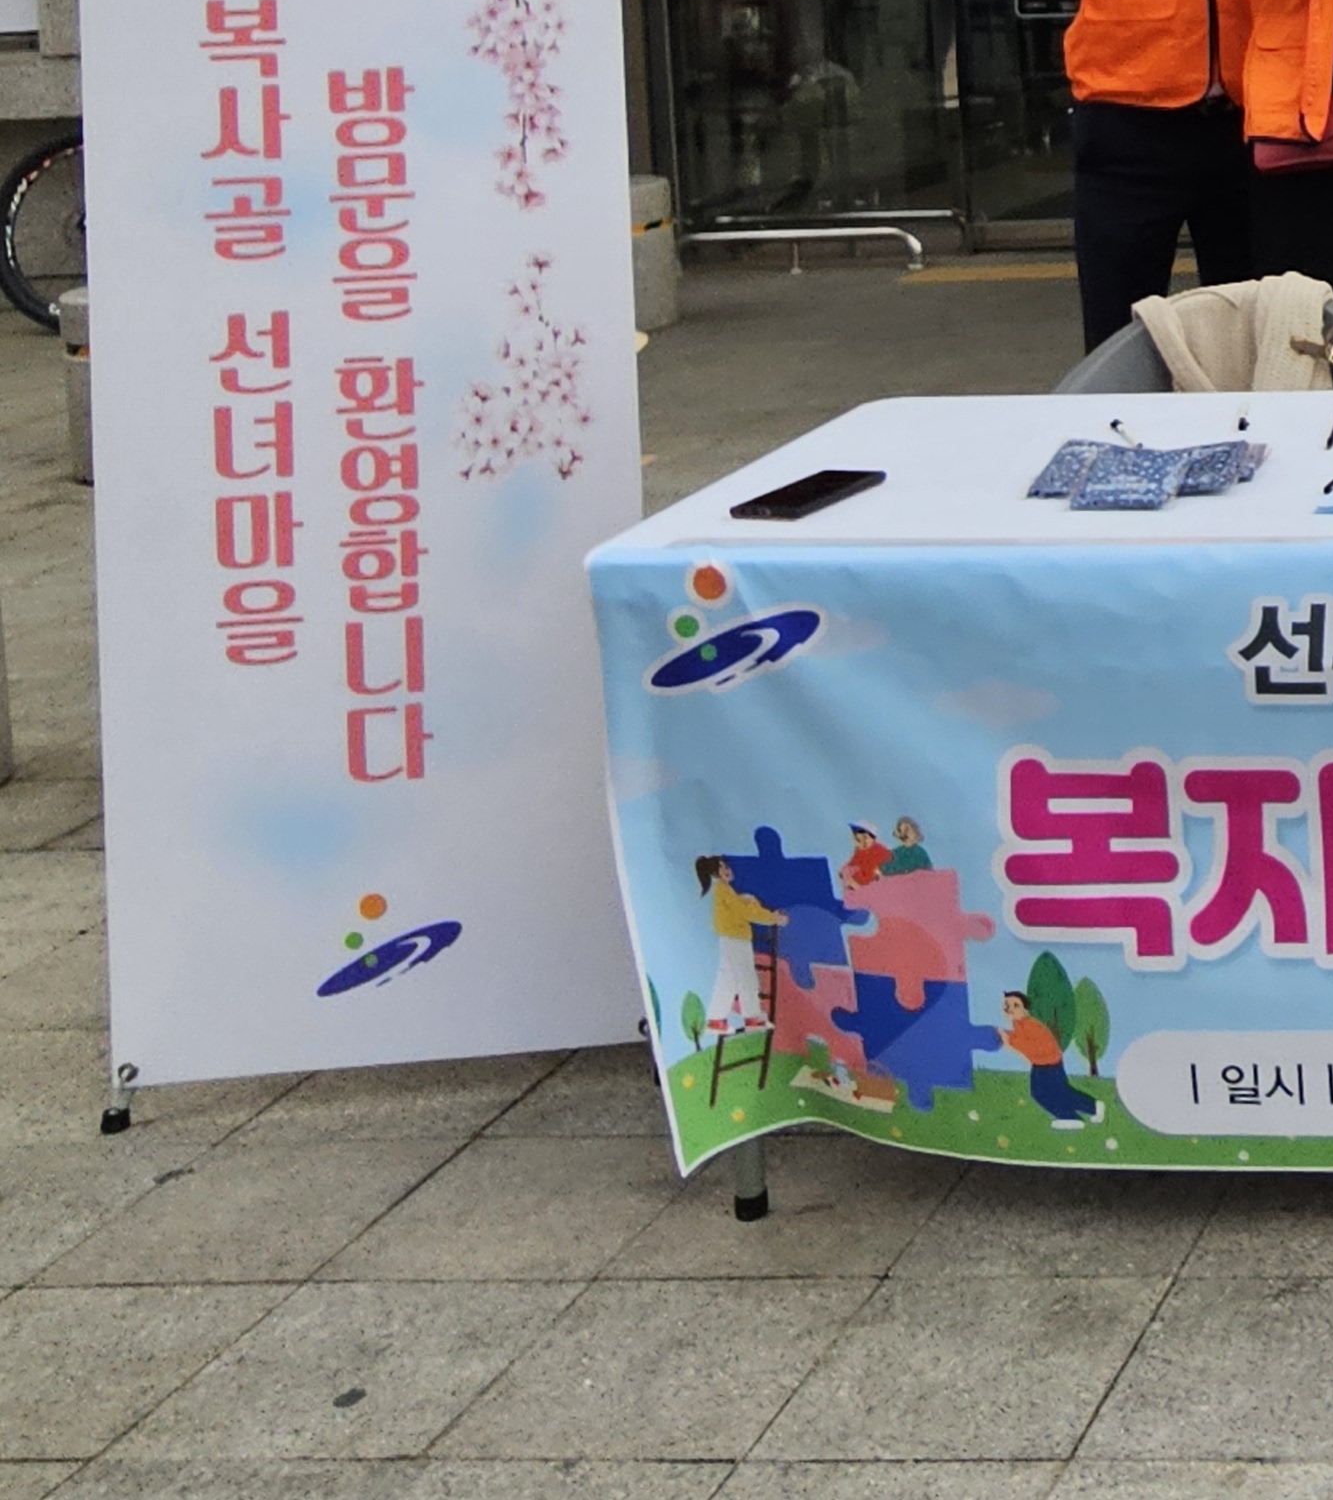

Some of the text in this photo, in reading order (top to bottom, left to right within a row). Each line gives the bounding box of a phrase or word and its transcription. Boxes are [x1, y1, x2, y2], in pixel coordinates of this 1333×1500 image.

[208, 309, 305, 668] 선녀마을
[327, 68, 436, 785] 방문을 환영합니다
[1221, 1063, 1307, 1105] 일시
